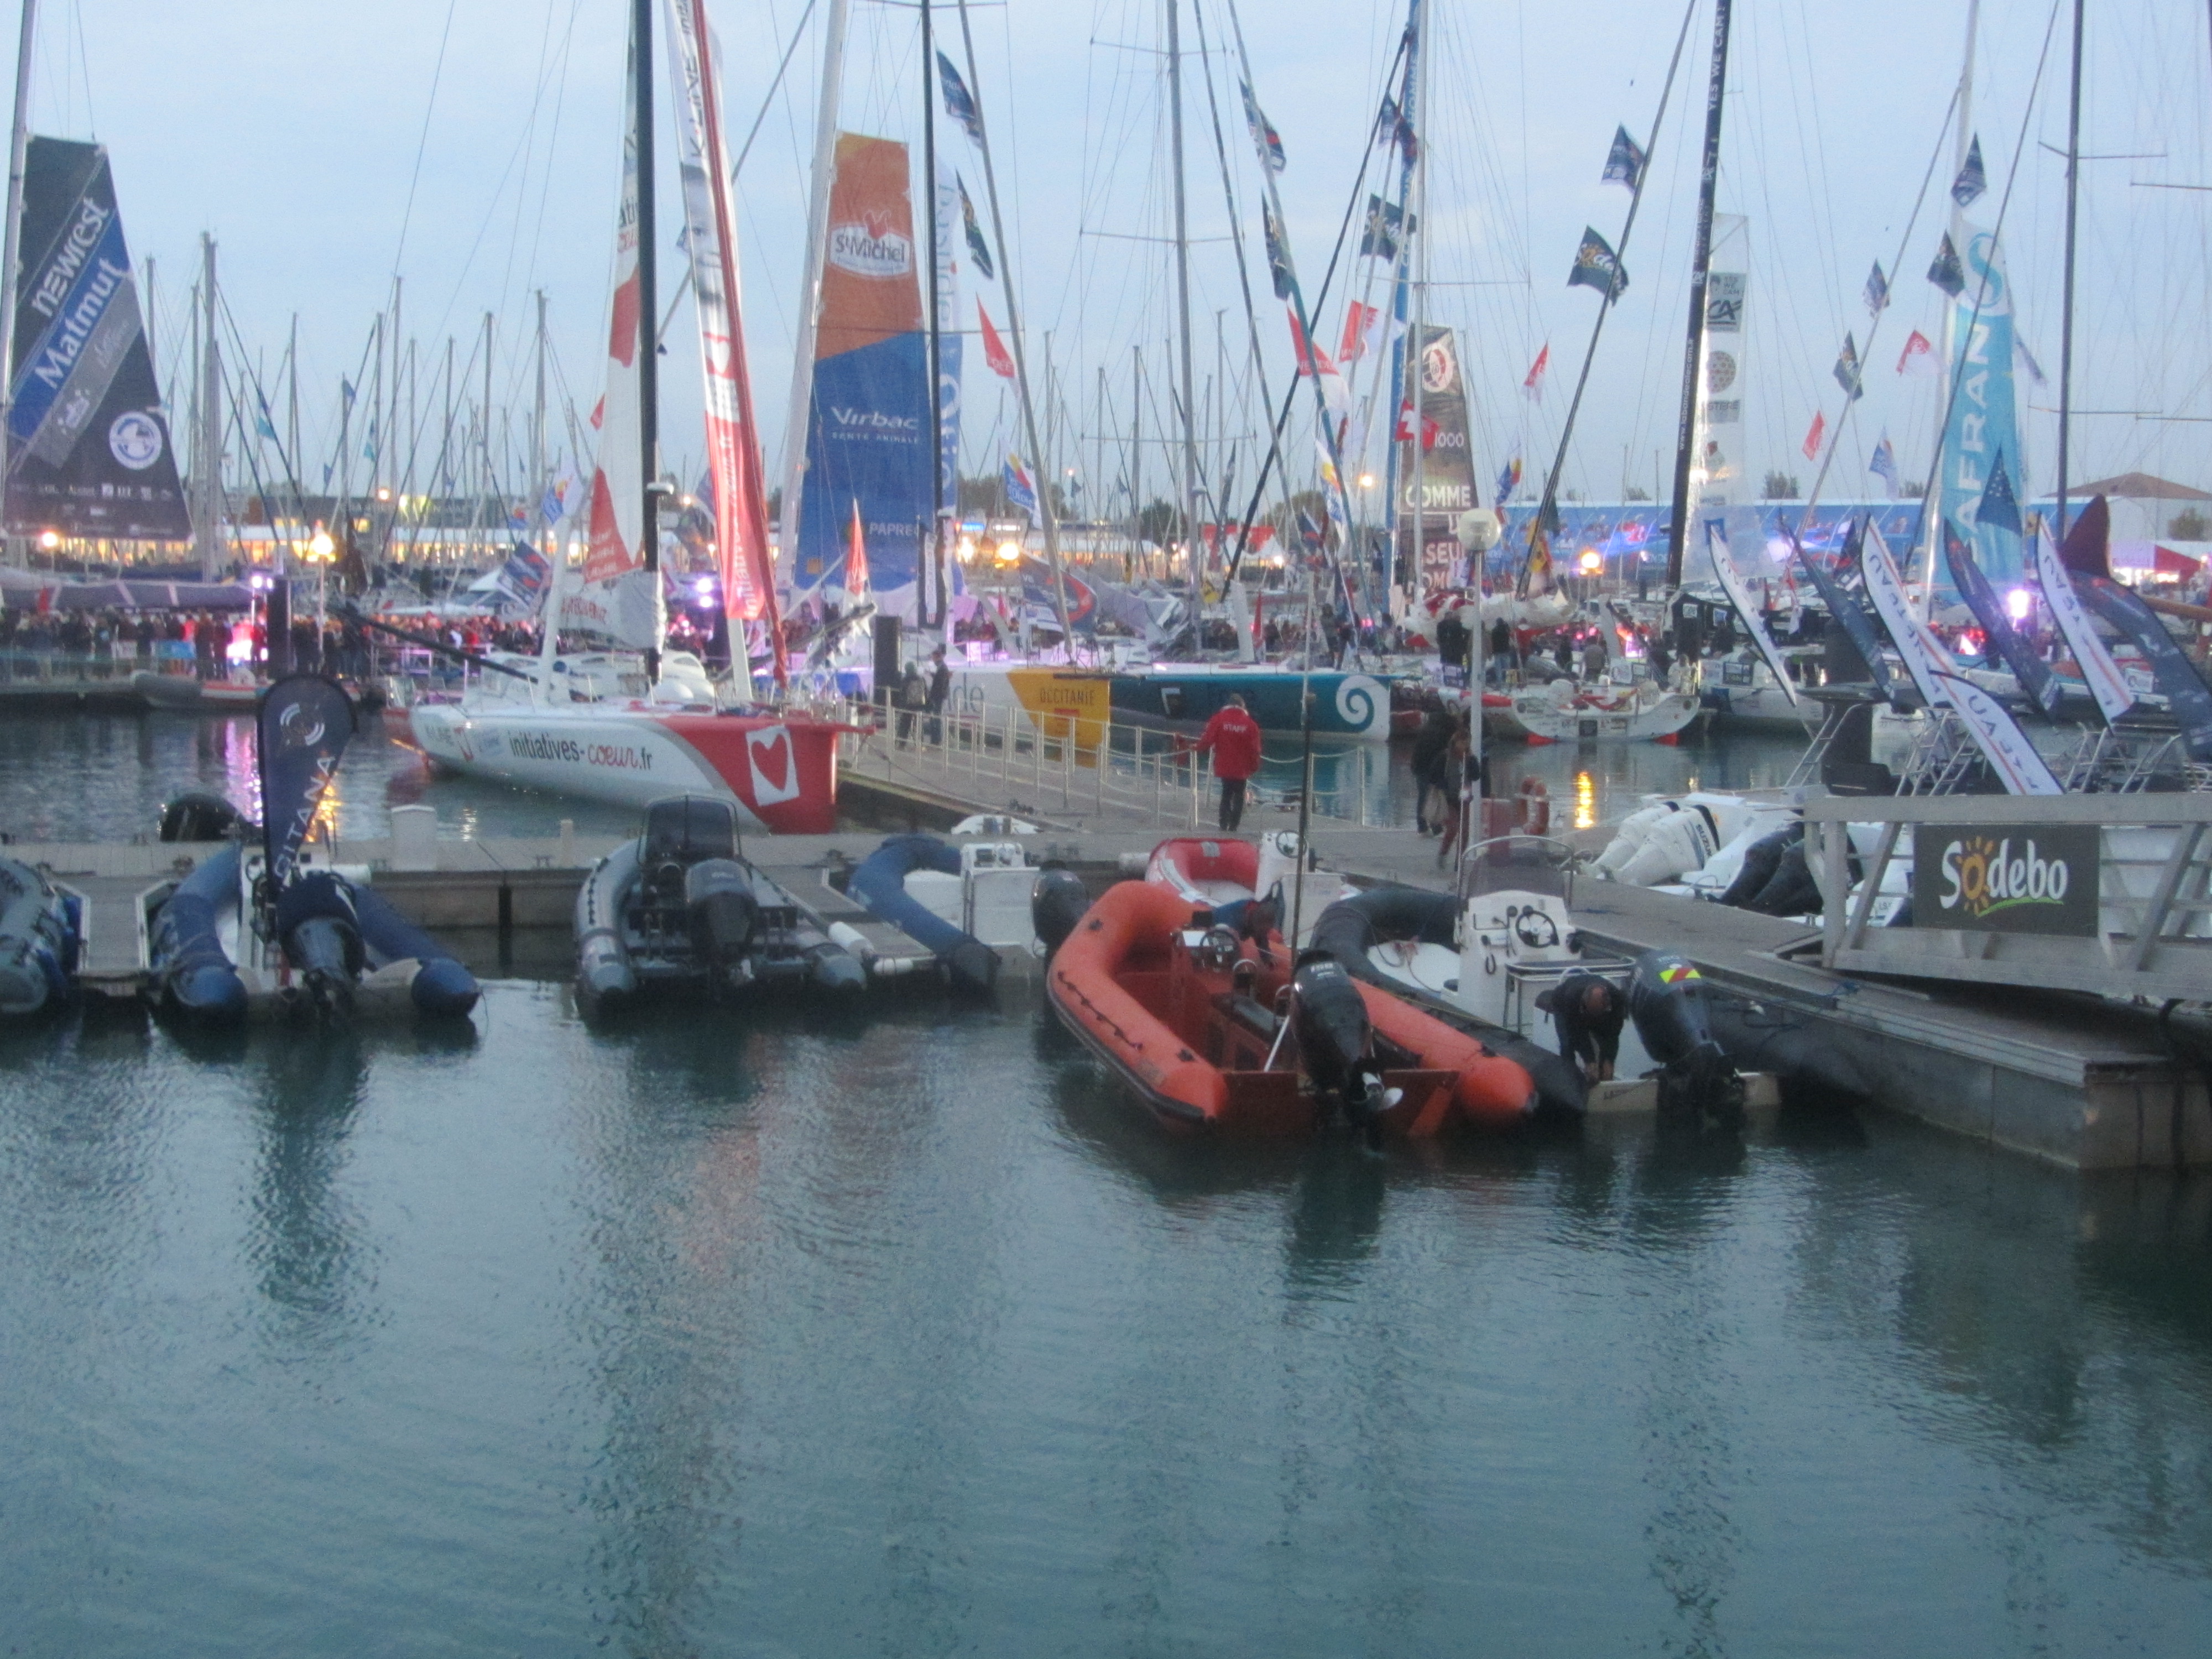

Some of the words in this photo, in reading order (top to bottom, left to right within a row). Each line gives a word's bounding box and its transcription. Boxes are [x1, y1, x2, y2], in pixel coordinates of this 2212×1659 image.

[34, 257, 121, 389] Matmut
[831, 406, 919, 430] Virbac
[1223, 723, 1248, 733] STAFF
[1939, 837, 2069, 910] Sodebo
